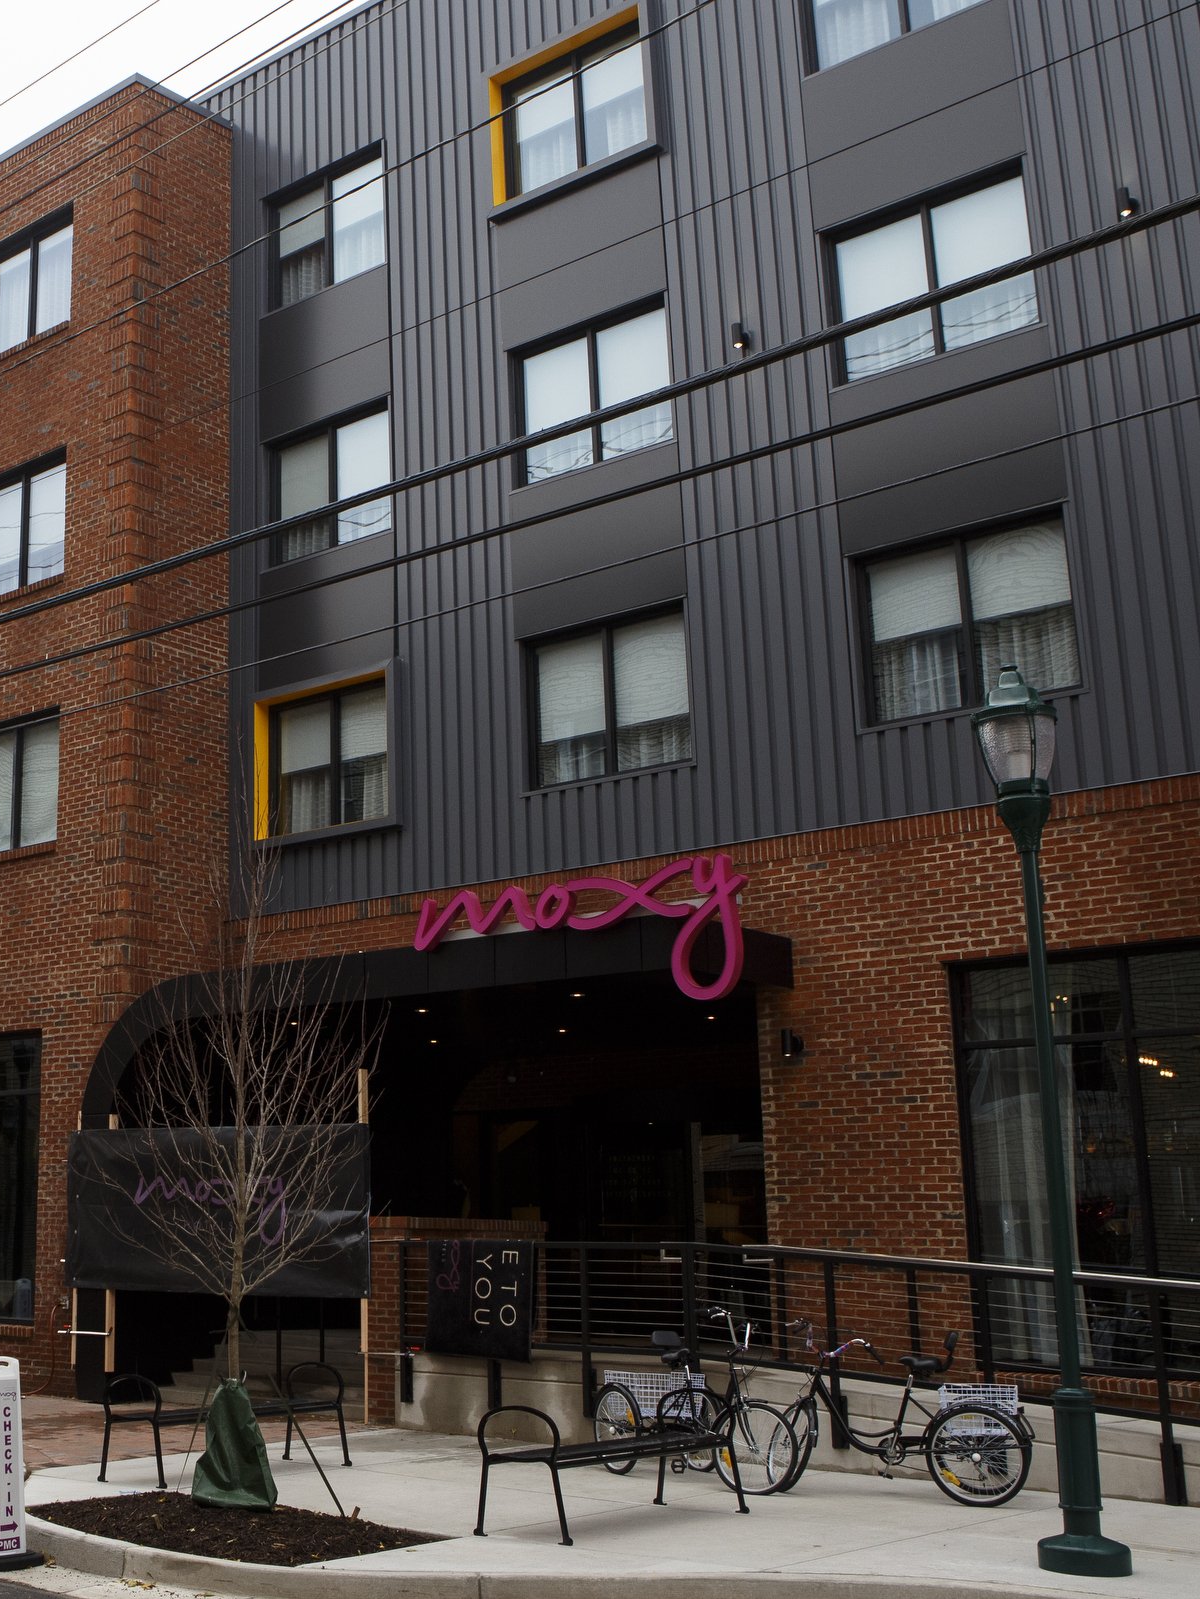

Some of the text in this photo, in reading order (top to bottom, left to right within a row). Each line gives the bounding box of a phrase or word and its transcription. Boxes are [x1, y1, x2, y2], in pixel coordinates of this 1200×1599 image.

[414, 853, 748, 1000] moxy
[474, 1254, 492, 1324] YOU
[500, 1280, 517, 1326] TO
